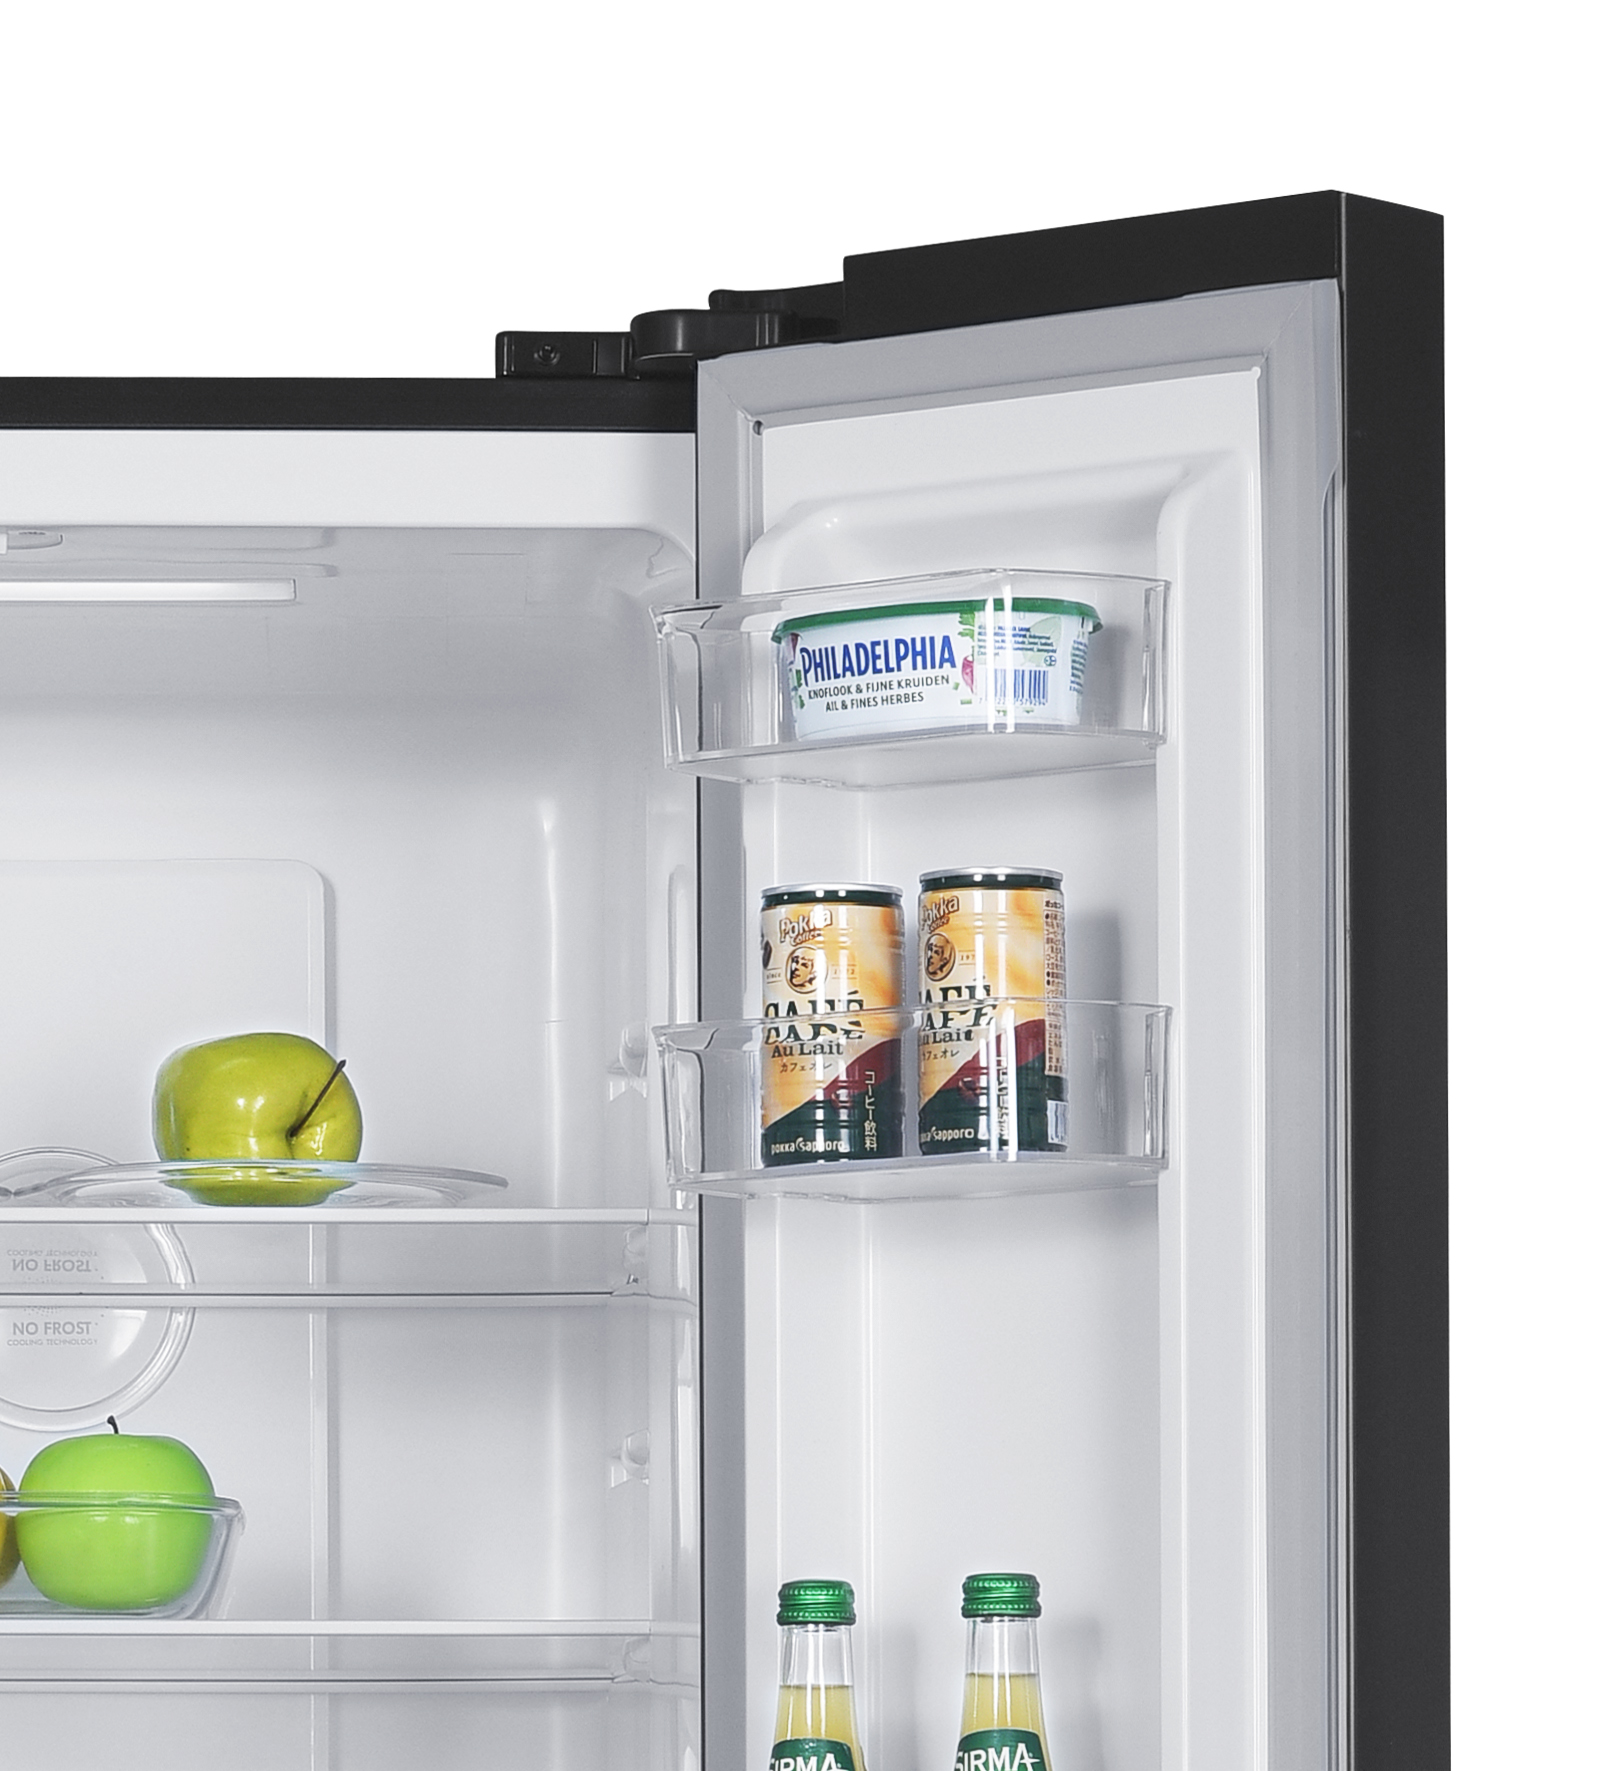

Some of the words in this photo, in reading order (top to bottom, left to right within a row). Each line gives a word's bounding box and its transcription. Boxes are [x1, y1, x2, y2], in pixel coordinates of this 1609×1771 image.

[799, 635, 957, 687] PHILADELPHIA
[808, 685, 853, 700] KNOFLOOK
[855, 683, 863, 694] &
[866, 680, 895, 693] FIJNE
[897, 674, 950, 690] KRUIDEN
[825, 701, 839, 712] AIL
[841, 699, 848, 710] &
[850, 696, 878, 709] FINES
[881, 691, 924, 706] HERBES
[779, 908, 833, 944] Poka
[771, 1043, 795, 1058] Au
[798, 1040, 844, 1056] Lait
[864, 1071, 877, 1152] コーヒー飲料
[797, 1140, 845, 1154] saporo
[12, 1322, 39, 1335] NO
[43, 1321, 92, 1335] FROST
[46, 1338, 98, 1346] TECHNOLOGY
